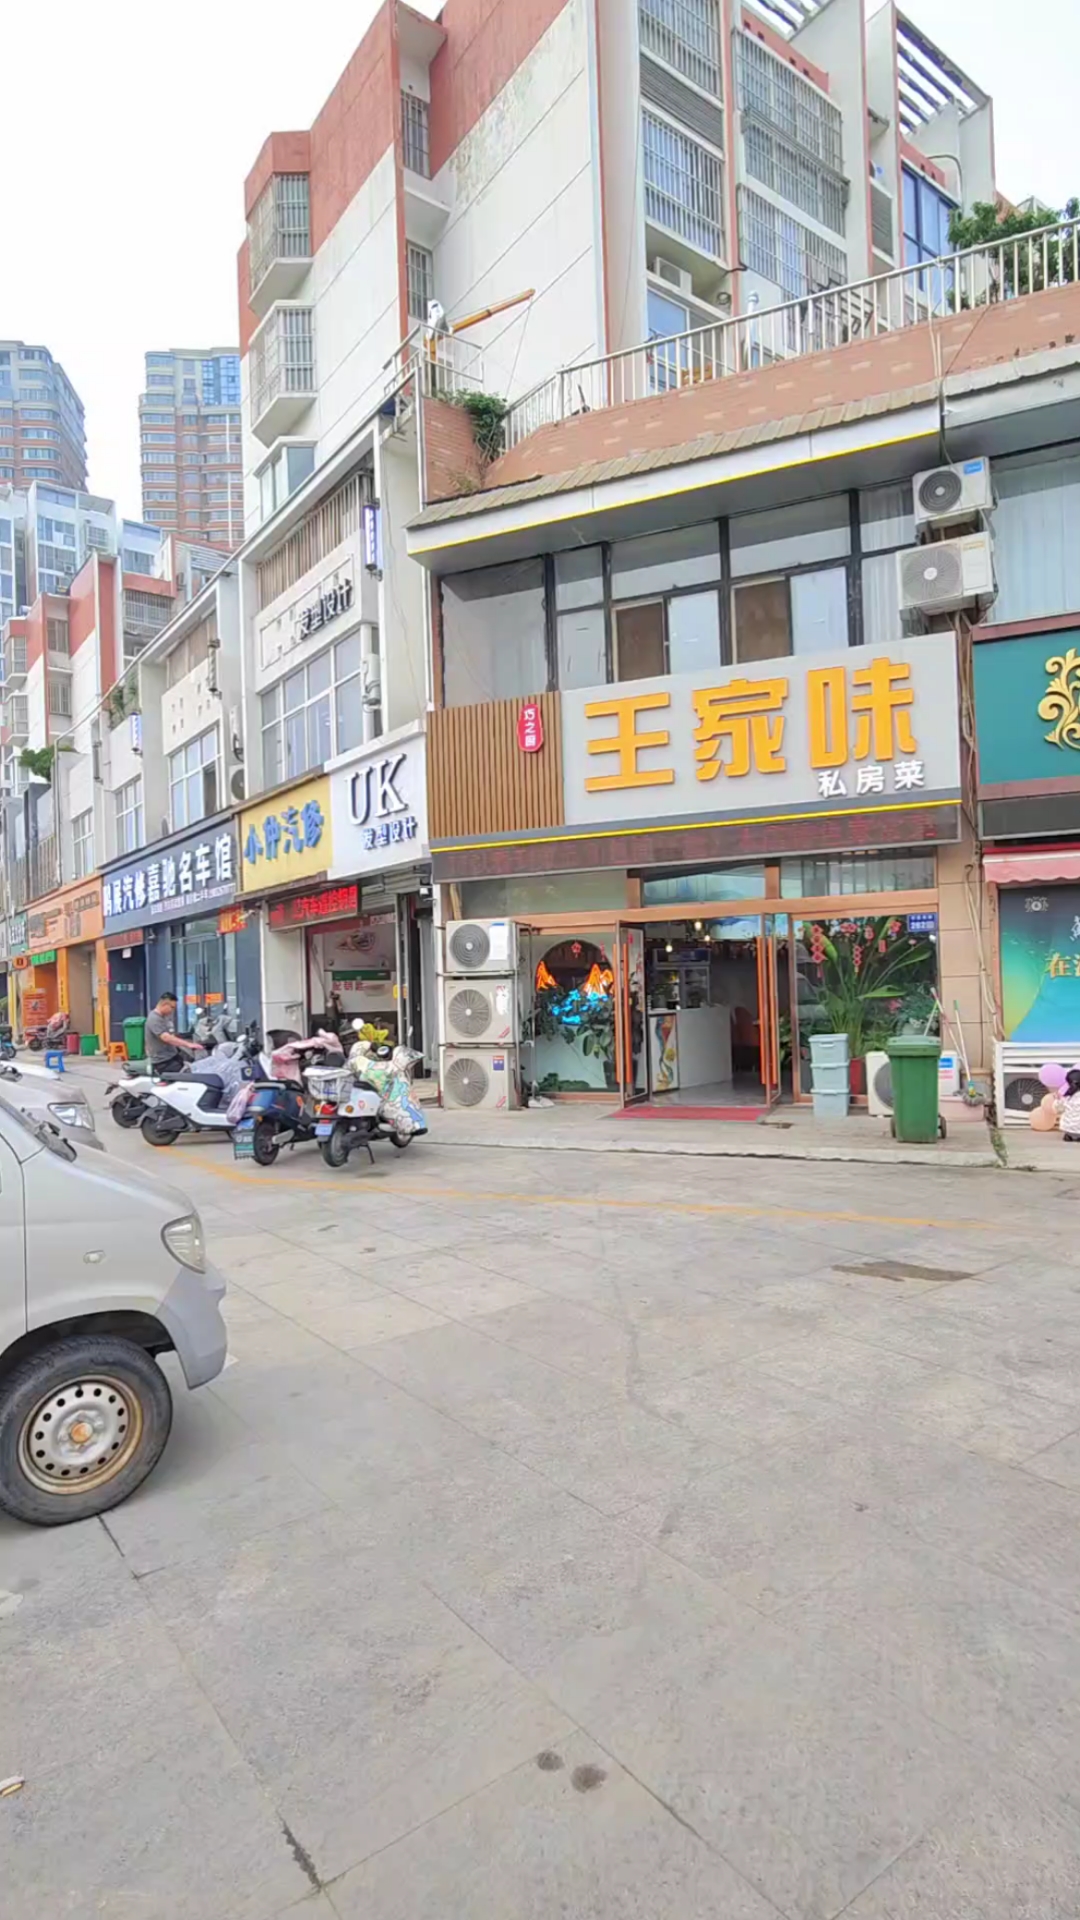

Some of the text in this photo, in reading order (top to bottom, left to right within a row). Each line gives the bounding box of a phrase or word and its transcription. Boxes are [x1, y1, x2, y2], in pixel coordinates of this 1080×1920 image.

[583, 656, 918, 794] 王家味
[344, 753, 408, 826] UK
[817, 758, 926, 799] 私房菜
[361, 815, 418, 850] 发型设计
